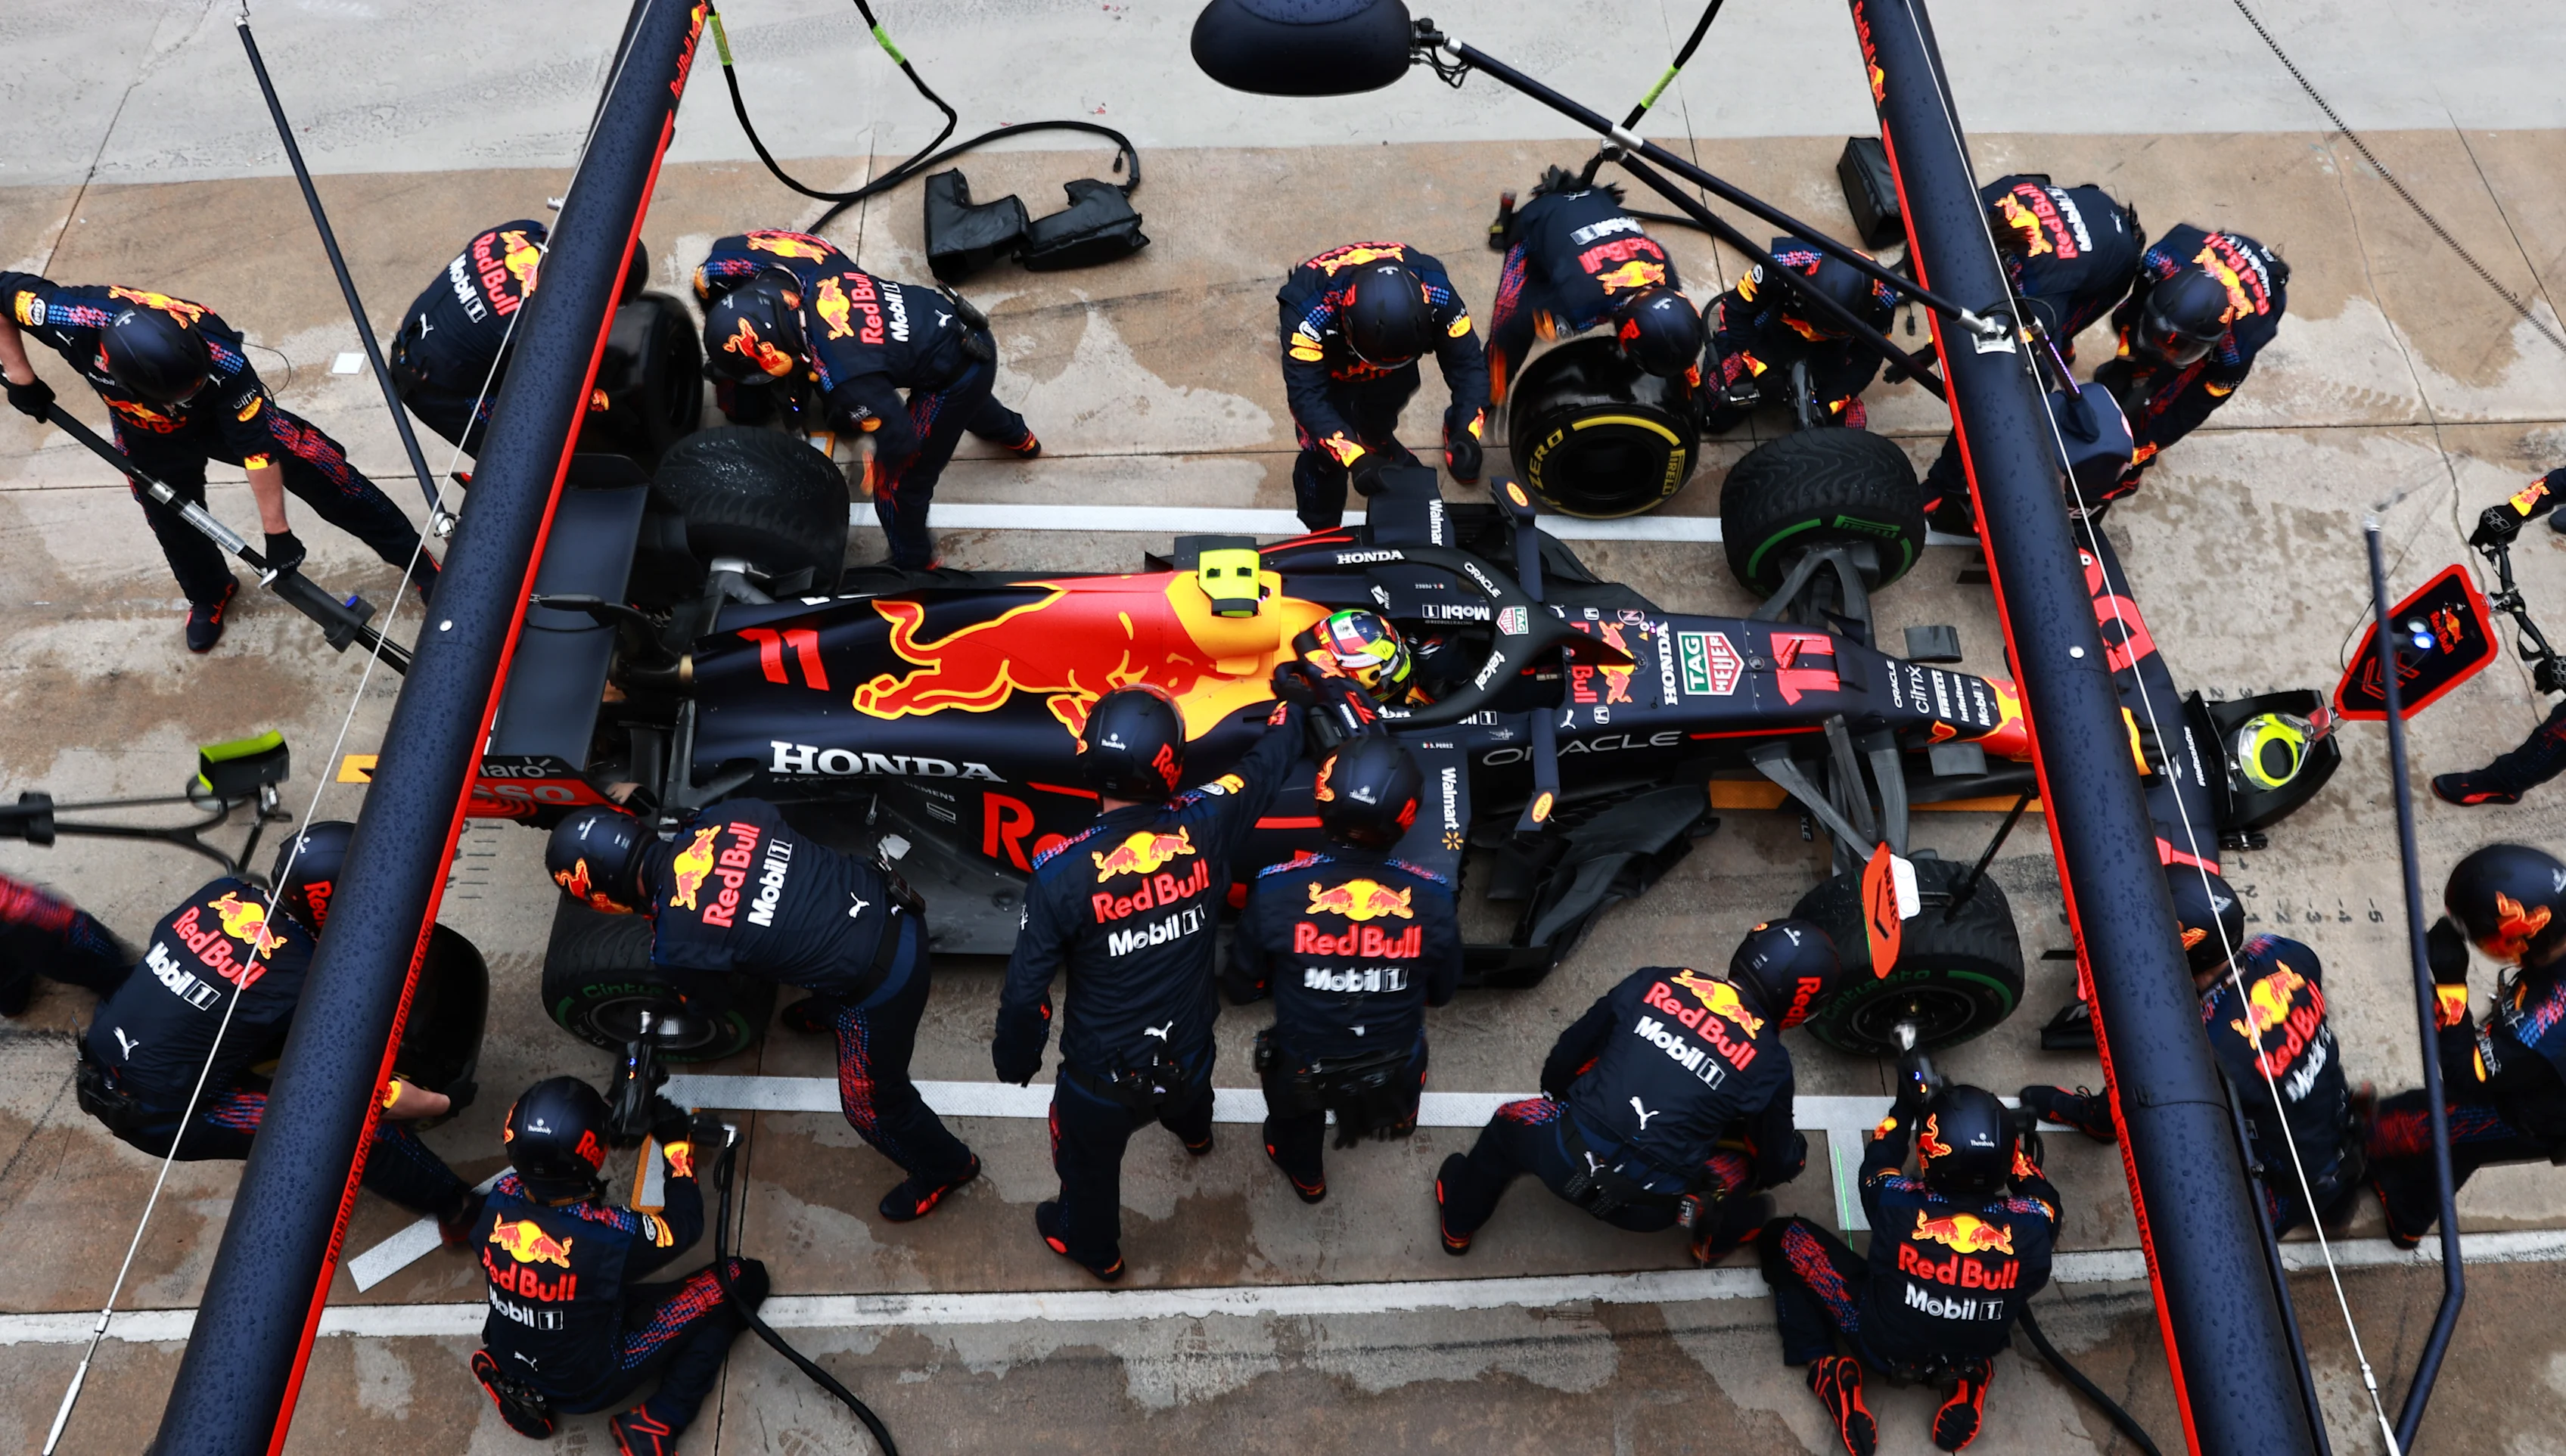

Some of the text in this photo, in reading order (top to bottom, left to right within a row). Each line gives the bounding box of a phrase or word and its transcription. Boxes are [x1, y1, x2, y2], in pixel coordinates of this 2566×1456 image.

[2012, 182, 2078, 259] Red Bull
[2058, 197, 2093, 252] Mobil
[449, 253, 477, 306] Mobil
[473, 231, 522, 316] Red Bull
[2238, 267, 2270, 315] Red
[843, 272, 884, 345] Red Bull
[884, 292, 910, 343] Mobil
[1528, 427, 1564, 491] ZERO
[1661, 449, 1686, 496] PIRELLI
[1429, 498, 1443, 546] Walmar
[1337, 549, 1406, 565] HONDA
[1464, 560, 1502, 598] ORACLE
[1441, 604, 1490, 621] Mobil
[1505, 607, 1514, 634] HEUER
[1515, 606, 1527, 634] TAG
[2430, 610, 2455, 655] Red Bull
[737, 628, 830, 691] 11
[1474, 650, 1506, 692] telcel
[1571, 665, 1598, 703] Bull
[1656, 620, 1679, 706] HONDA
[1685, 636, 1705, 691] TAG
[1707, 635, 1736, 692] HEUER
[1770, 632, 1841, 706] 11
[1886, 659, 1903, 709] ORACLE
[1905, 663, 1931, 715] citrix
[1931, 669, 1952, 719] PIRELLI
[1952, 672, 1971, 723] Infinitum
[1971, 690, 1992, 728] Mobil
[480, 762, 546, 778] laro
[769, 740, 1008, 783] HONDA
[1151, 742, 1183, 793] Red
[902, 781, 956, 803] SIEMENS
[1441, 766, 1460, 830] Walmart
[702, 821, 761, 929] Red Bull
[747, 858, 791, 927] Mobil
[1092, 857, 1210, 924] Red Bull
[1884, 866, 1899, 931] BRAKES
[1108, 913, 1181, 958] Mobil
[1294, 920, 1421, 959] Red Bull
[2276, 911, 2293, 924] 2
[2306, 911, 2322, 924] 3
[2368, 910, 2384, 924] 5
[144, 940, 197, 997] Mobil
[172, 905, 267, 991] Red Bull
[1303, 965, 1382, 993] Mobil
[1786, 976, 1822, 1023] Red
[1633, 1015, 1706, 1072] Mobil
[1643, 981, 1758, 1072] Red Bull
[2254, 978, 2326, 1083] Red Bull
[575, 1128, 608, 1172] Red
[1970, 1139, 1995, 1149] Therabody
[483, 1245, 578, 1302] Red Bull
[1897, 1241, 2020, 1291] Red Bull
[489, 1284, 535, 1329] Mobil
[1904, 1281, 1977, 1321] Mobil
